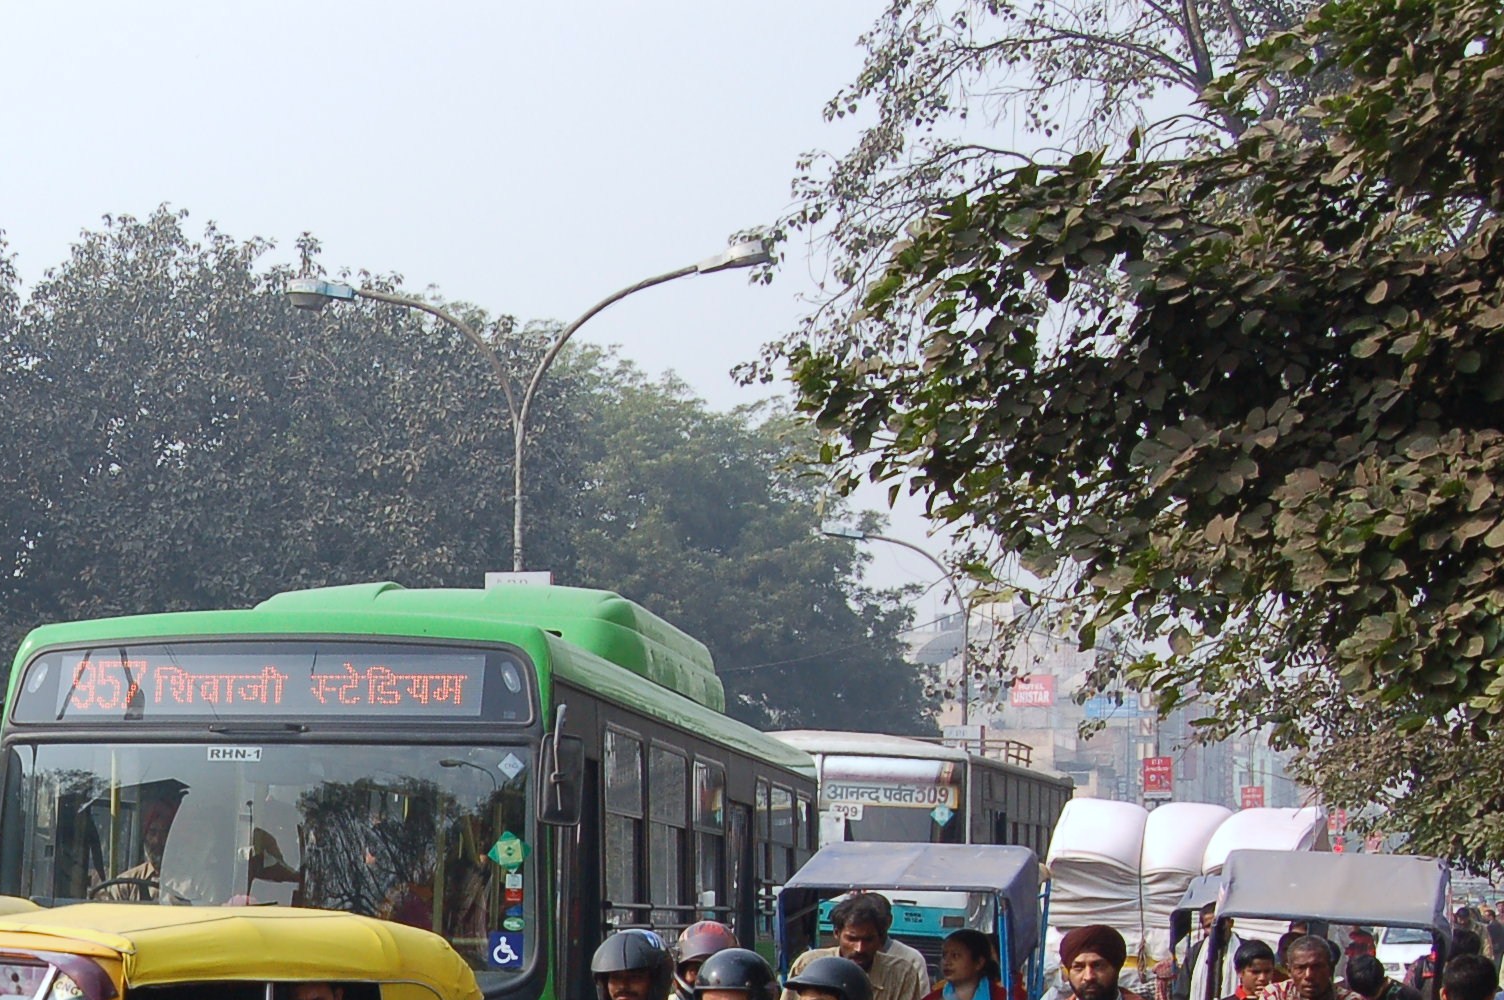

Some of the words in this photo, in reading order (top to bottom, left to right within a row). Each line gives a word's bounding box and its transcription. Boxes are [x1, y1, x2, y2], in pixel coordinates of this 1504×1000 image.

[73, 660, 146, 710] 957
[154, 665, 289, 705] शिवाजी
[311, 662, 468, 705] स्टेडियम
[1012, 691, 1050, 704] UNISTAR
[210, 749, 261, 760] RHN-1
[827, 784, 880, 803] आनन्द
[883, 784, 916, 803] पर्वत
[55, 980, 81, 996] CNG
